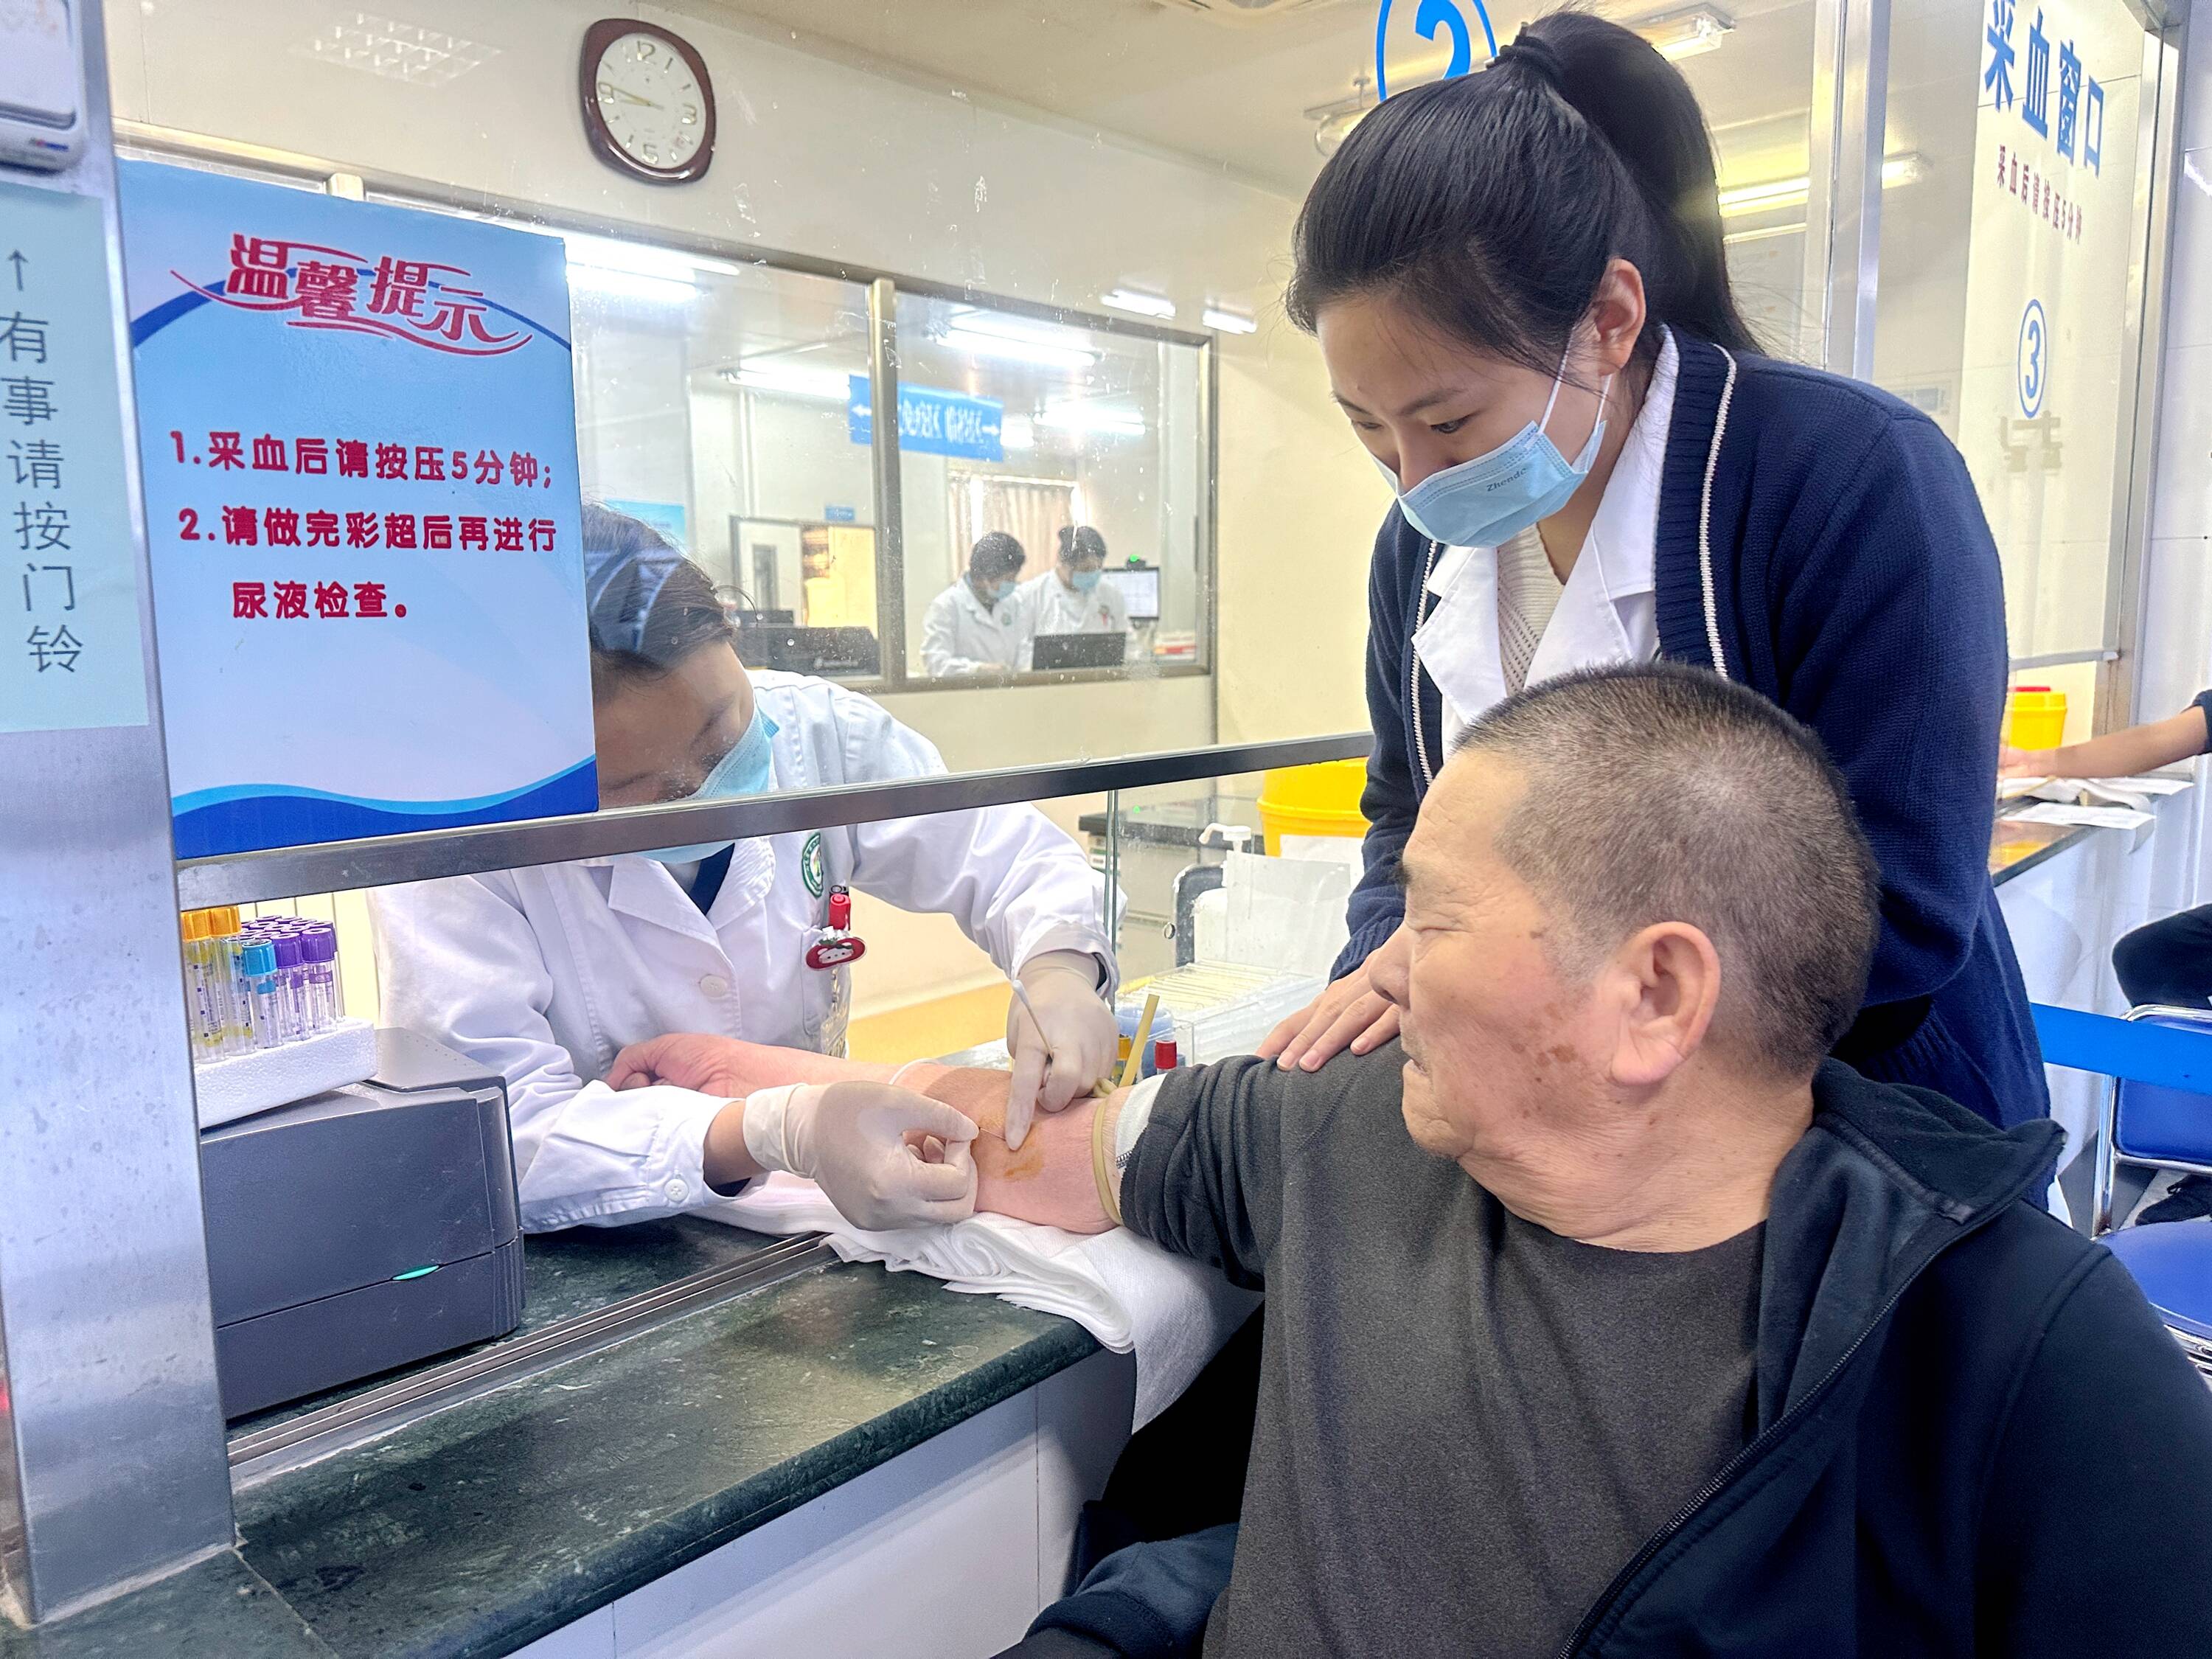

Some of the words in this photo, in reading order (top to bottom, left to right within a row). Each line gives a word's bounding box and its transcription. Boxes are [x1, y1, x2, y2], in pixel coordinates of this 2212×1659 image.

[1984, 0, 2104, 179] 采血窗口
[226, 234, 518, 343] 温馨提示
[2025, 319, 2040, 398] 3
[0, 310, 83, 673] 有事请按门铃
[178, 505, 557, 552] 2.请做完彩超后再进行
[232, 580, 407, 619] 尿液检查。
